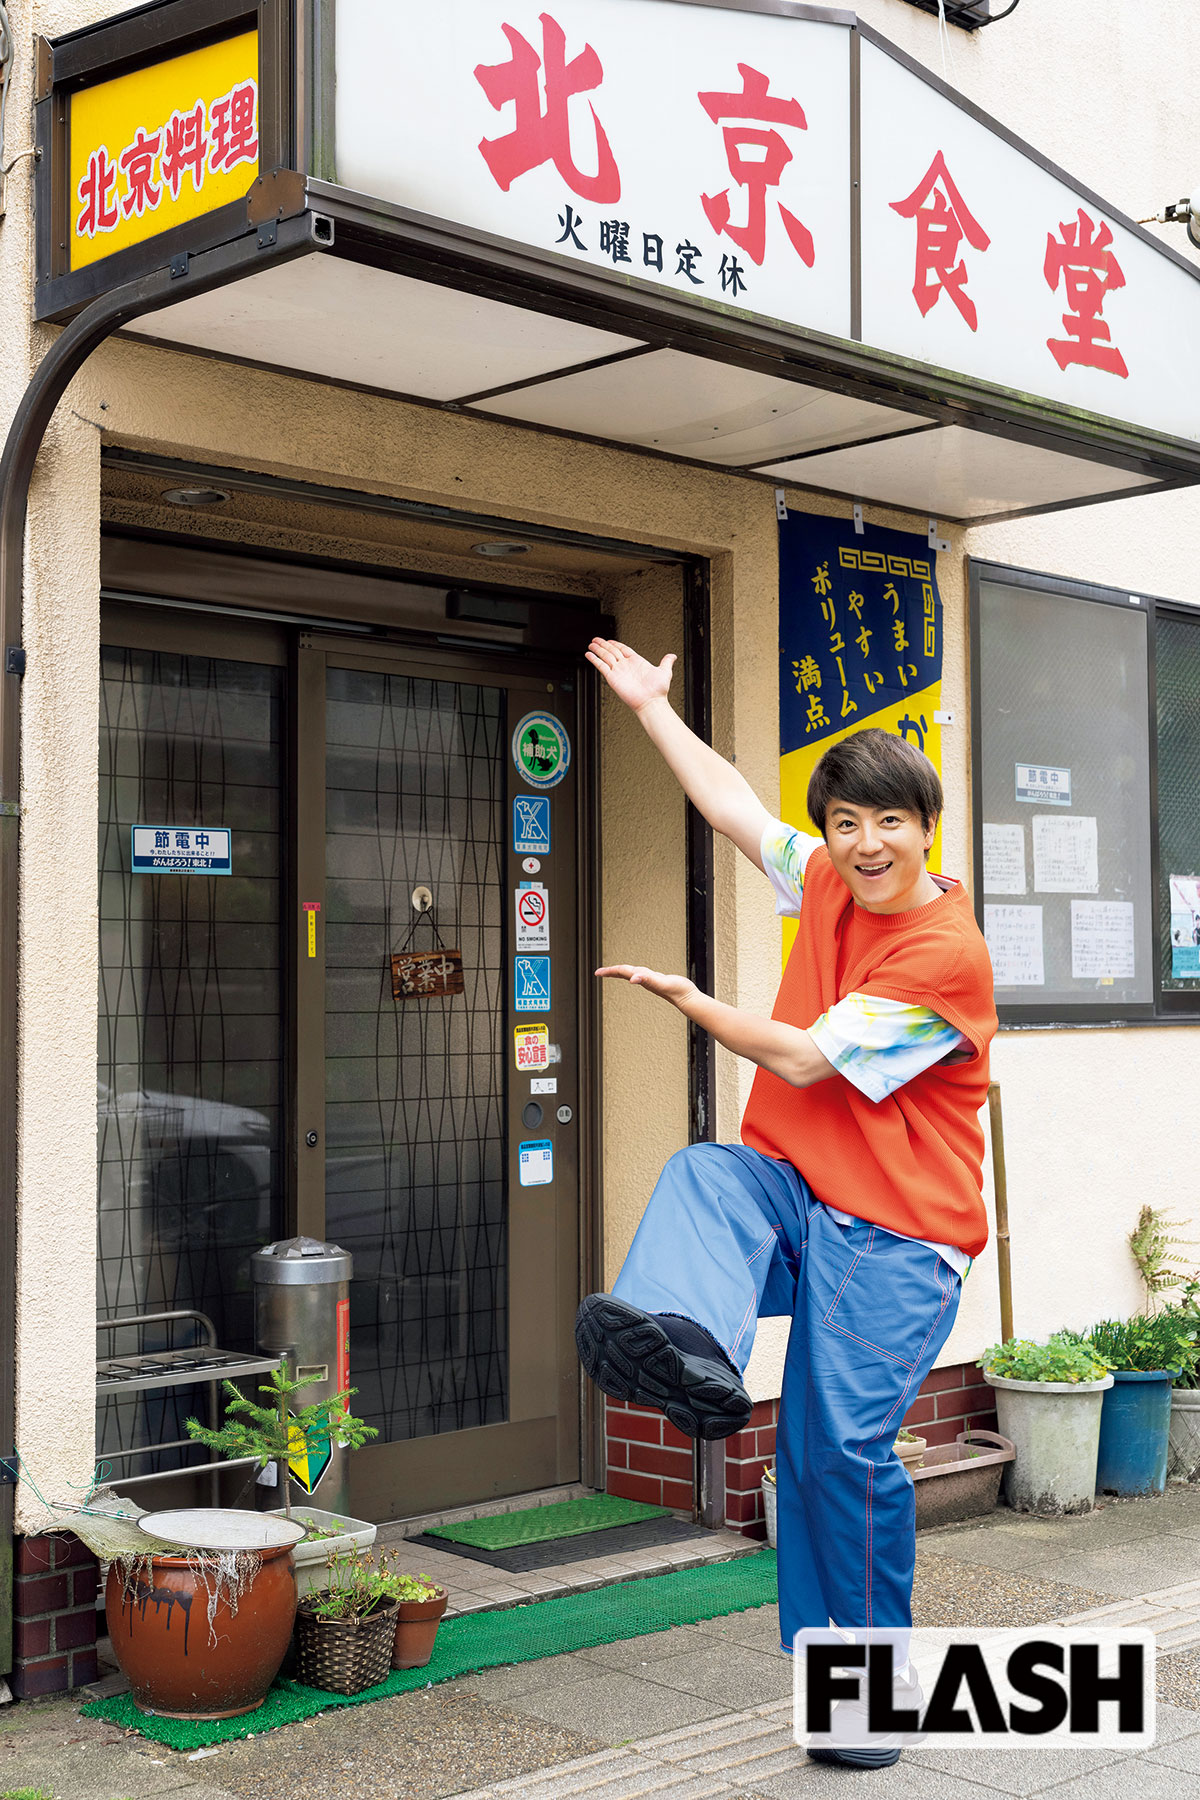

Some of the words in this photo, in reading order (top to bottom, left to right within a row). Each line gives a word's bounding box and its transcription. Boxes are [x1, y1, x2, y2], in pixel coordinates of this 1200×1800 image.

[77, 80, 258, 237] 北京料理
[473, 12, 1129, 379] 北京食堂
[555, 204, 748, 298] 火曜日定休
[810, 560, 858, 719] ボリューム
[848, 590, 885, 694] やすい
[883, 582, 918, 687] うまい
[791, 655, 831, 733] 満点
[522, 741, 558, 760] 補助犬
[1028, 769, 1059, 785] 節電中
[154, 830, 210, 850] 節電中
[397, 954, 455, 995] 営業中
[517, 1045, 547, 1065] 安心宣言
